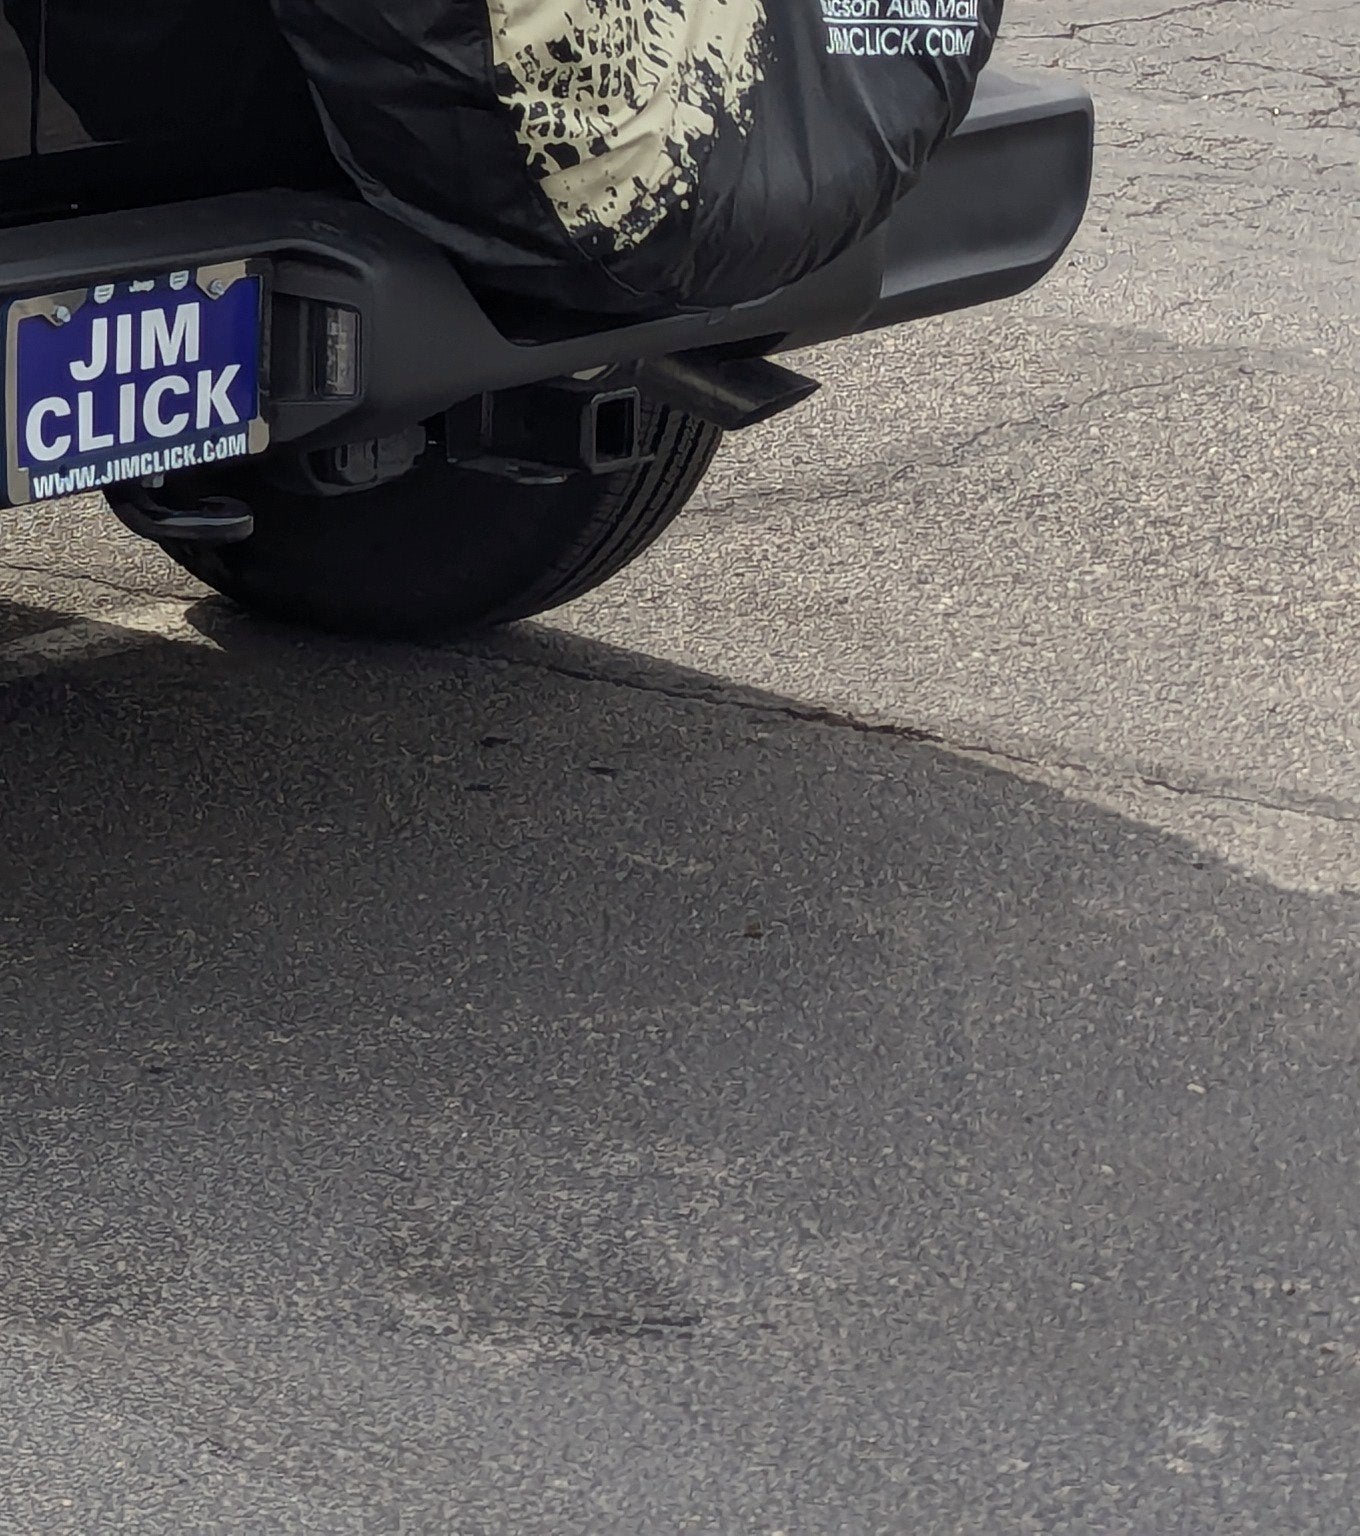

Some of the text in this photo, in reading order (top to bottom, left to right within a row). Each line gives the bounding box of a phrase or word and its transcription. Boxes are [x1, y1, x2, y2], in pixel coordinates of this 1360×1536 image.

[69, 302, 200, 382] JIM
[25, 364, 242, 462] CLICK
[32, 433, 247, 499] WWW.JIMCLICK.COM
